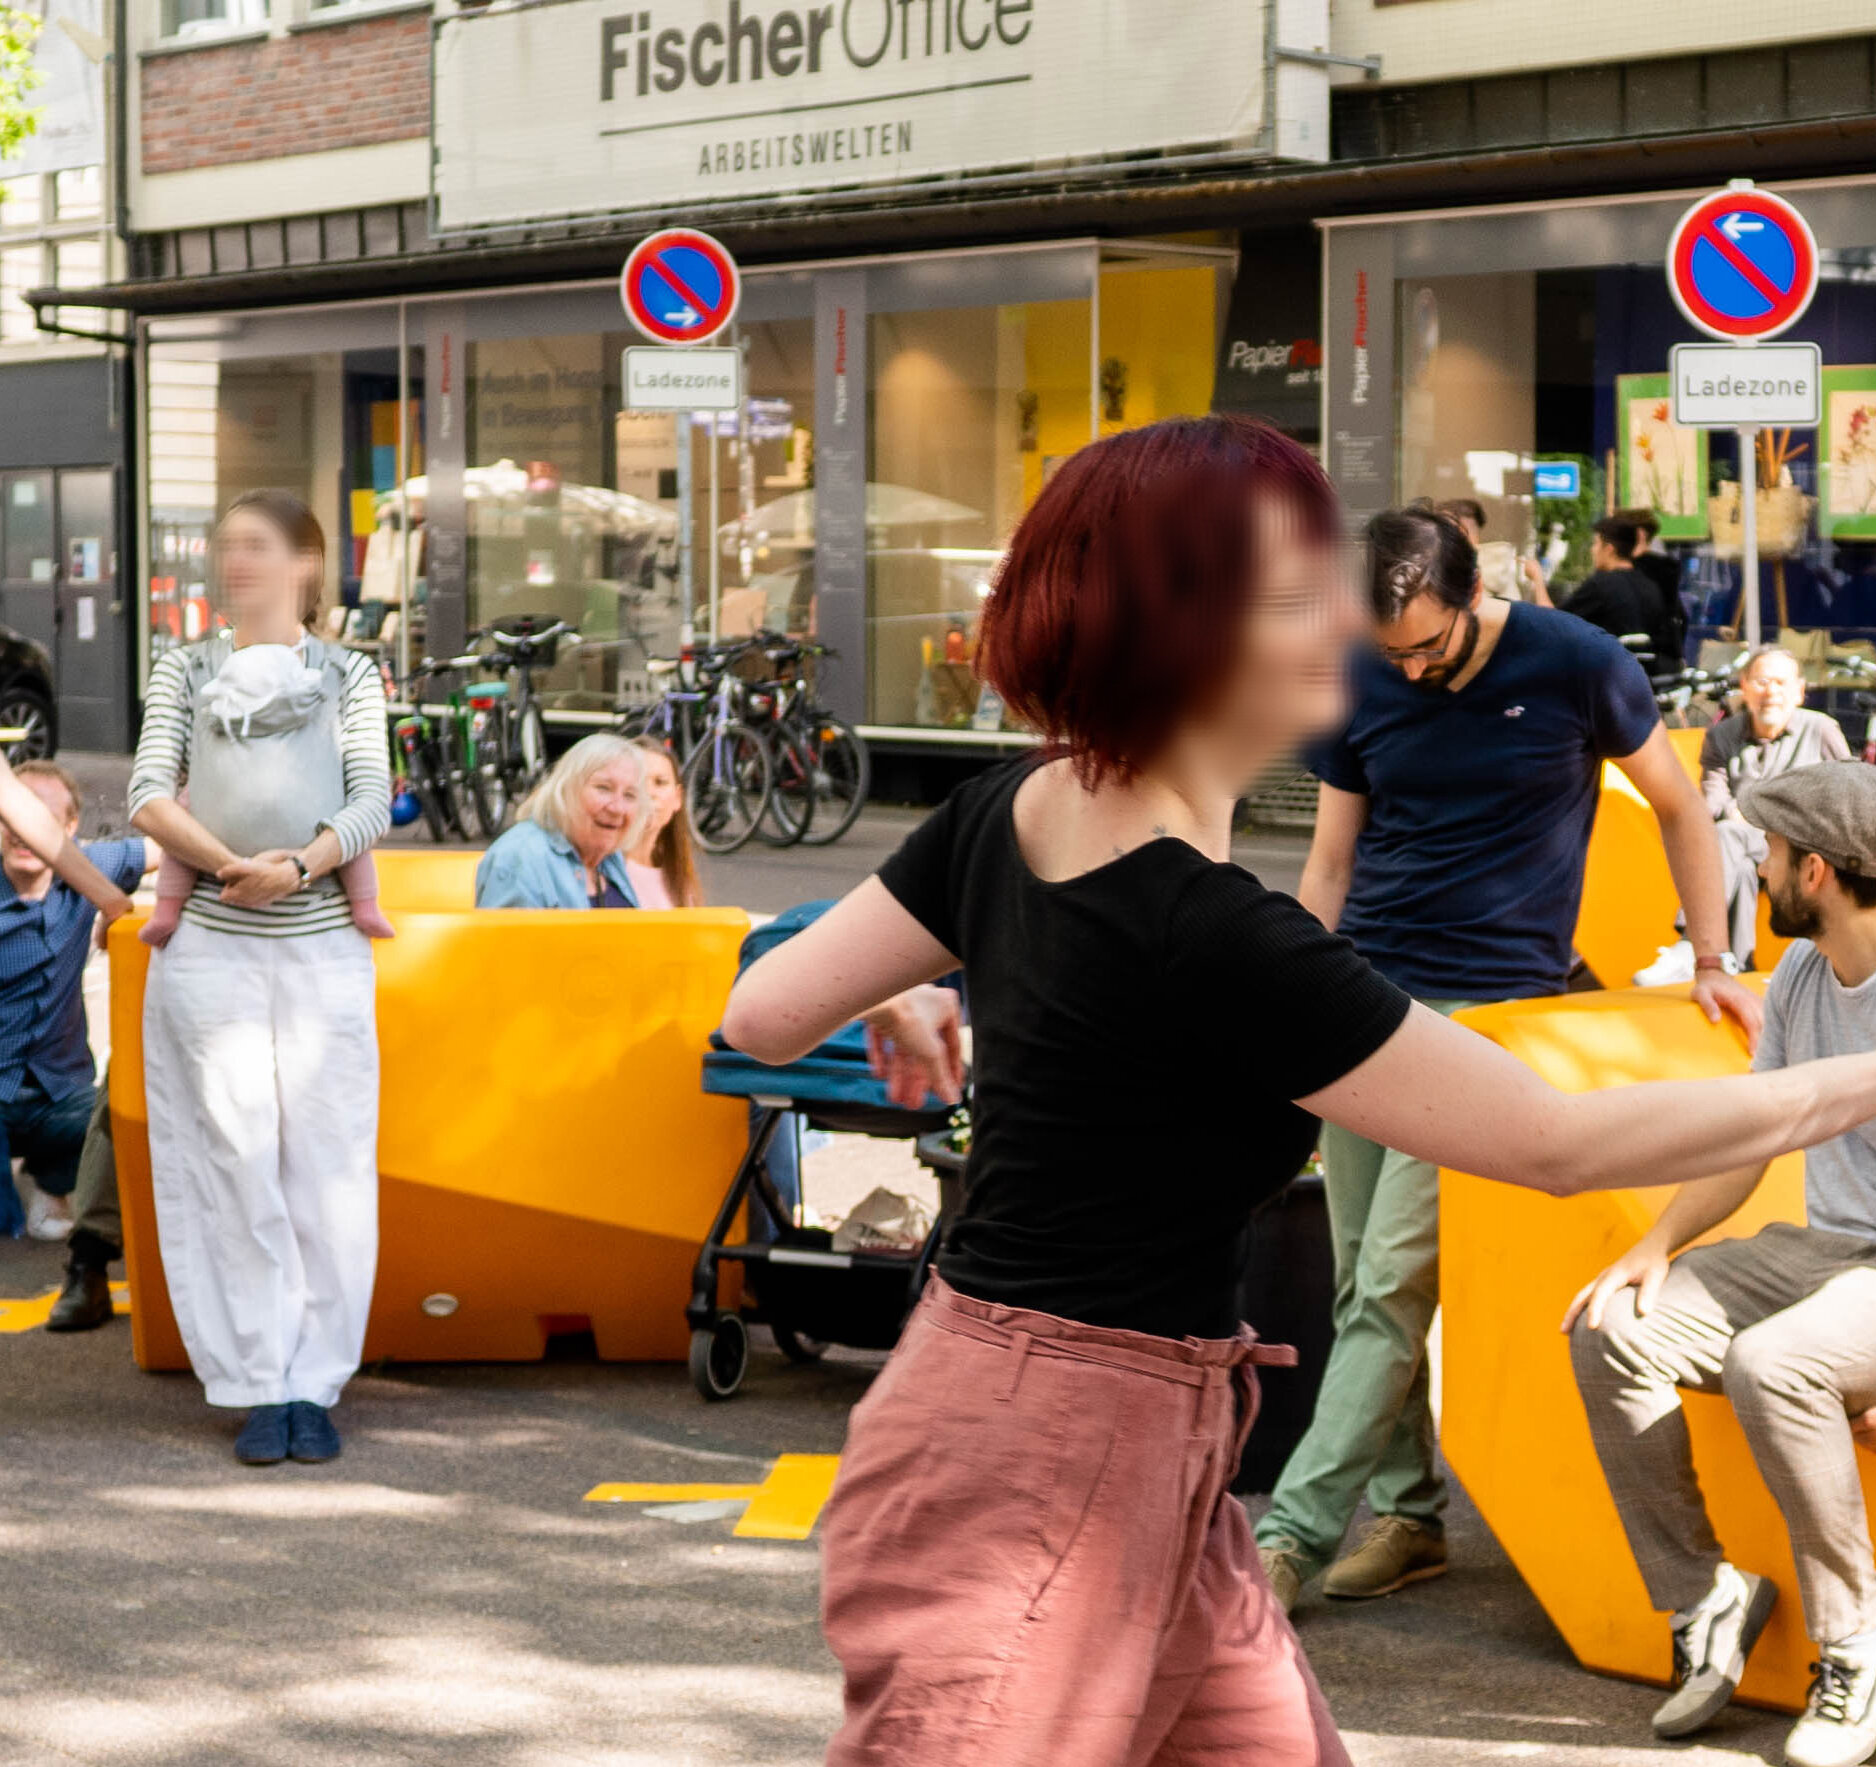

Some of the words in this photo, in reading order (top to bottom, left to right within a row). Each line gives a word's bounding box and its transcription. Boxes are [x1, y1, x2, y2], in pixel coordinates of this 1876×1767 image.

[700, 120, 914, 175] ARBEITSWELTEN
[634, 370, 731, 388] Ladezone
[1685, 374, 1808, 397] Ladezone
